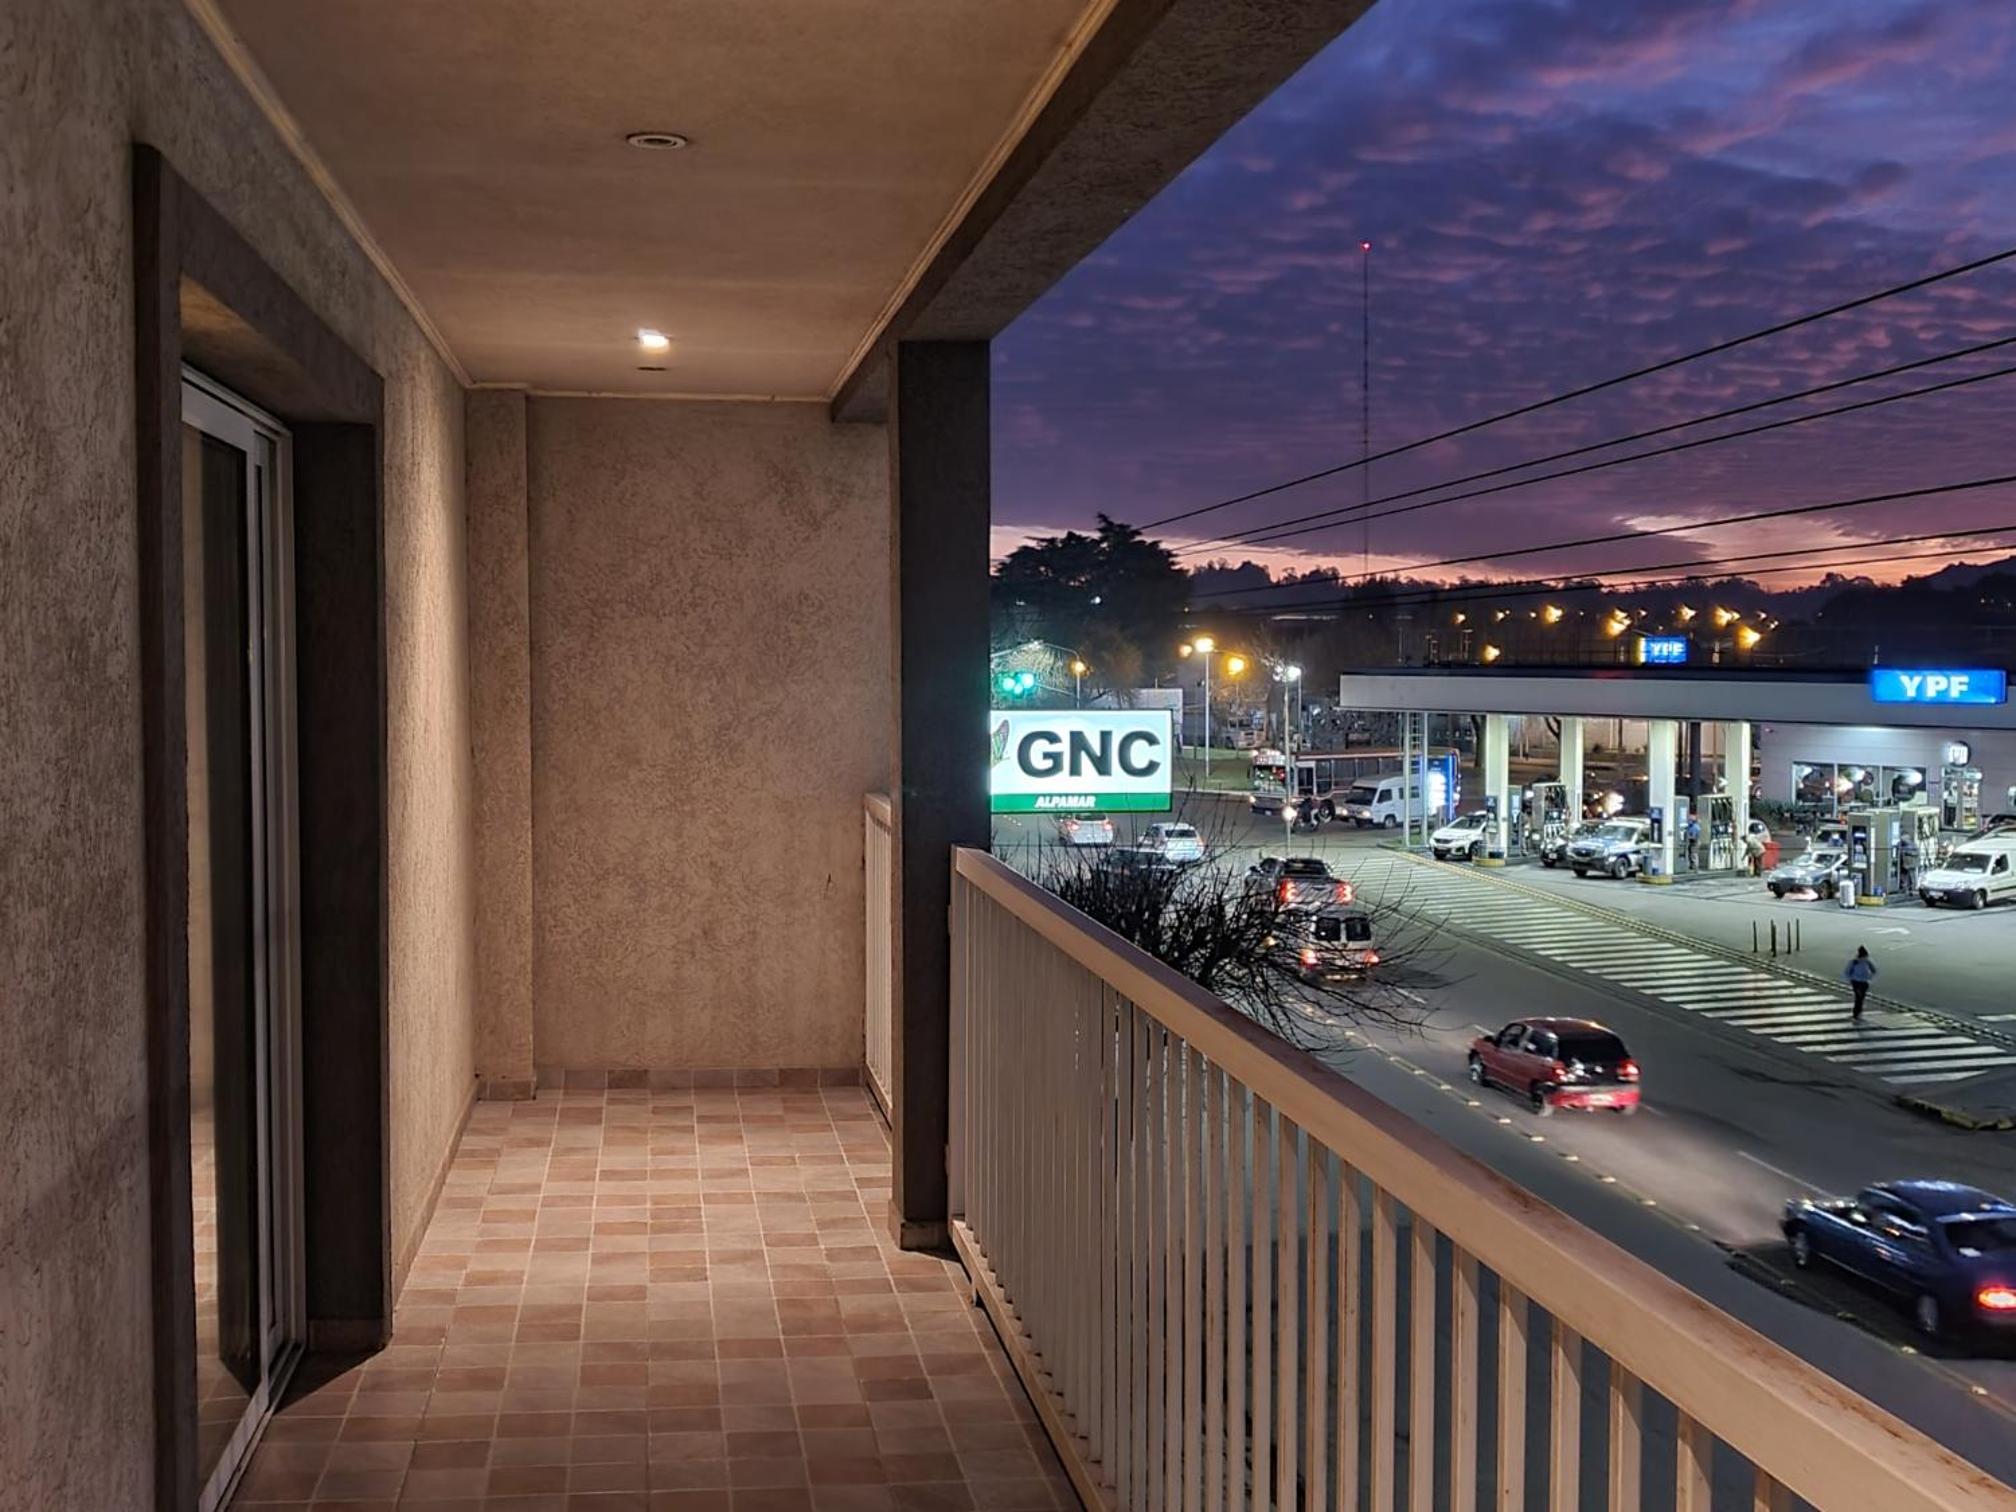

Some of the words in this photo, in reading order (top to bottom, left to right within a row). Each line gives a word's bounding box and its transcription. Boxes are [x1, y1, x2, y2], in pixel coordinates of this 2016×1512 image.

[1900, 675, 1969, 698] YPF
[1016, 729, 1162, 778] GNC
[1034, 795, 1096, 808] ALPAMAR
